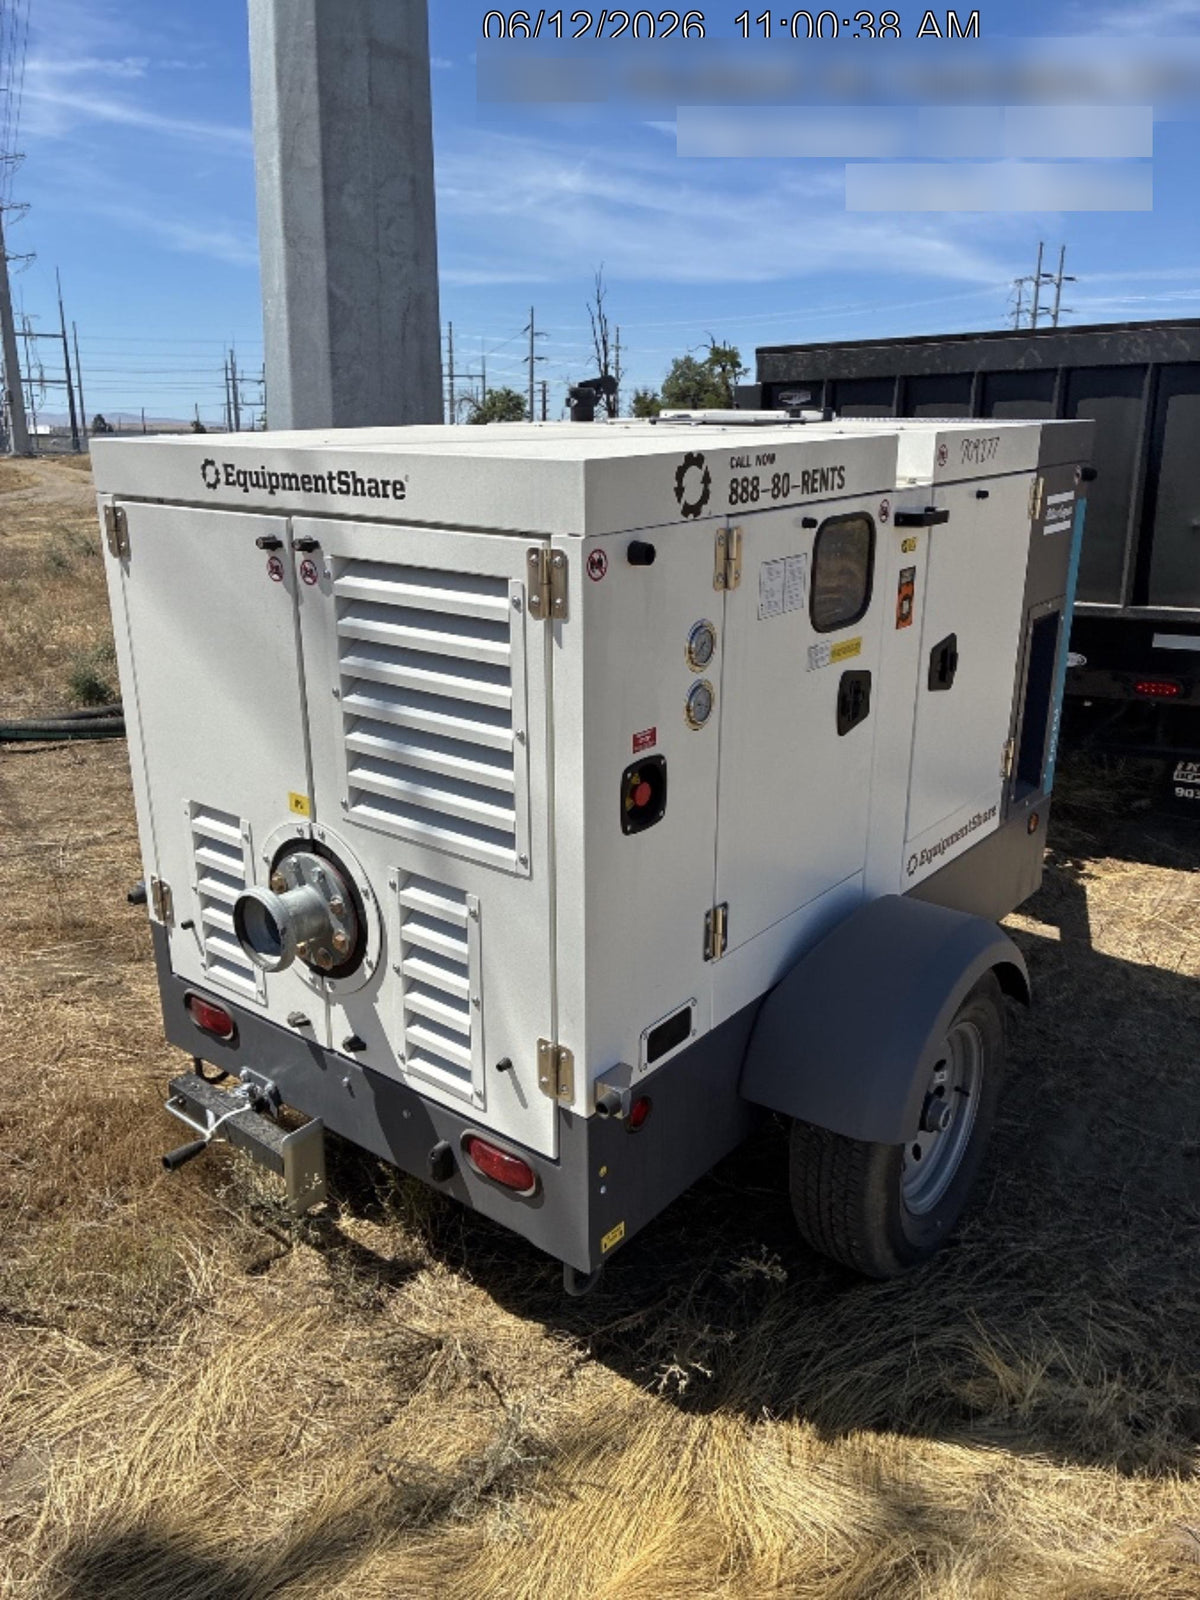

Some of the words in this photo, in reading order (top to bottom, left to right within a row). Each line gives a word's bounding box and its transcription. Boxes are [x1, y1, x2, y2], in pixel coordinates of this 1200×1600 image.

[730, 455, 752, 469] CALL
[755, 453, 776, 467] NOW
[222, 462, 407, 500] EquipmentShare
[728, 465, 846, 505] 888-80-RENTS
[919, 805, 997, 866] EquipmentShare
